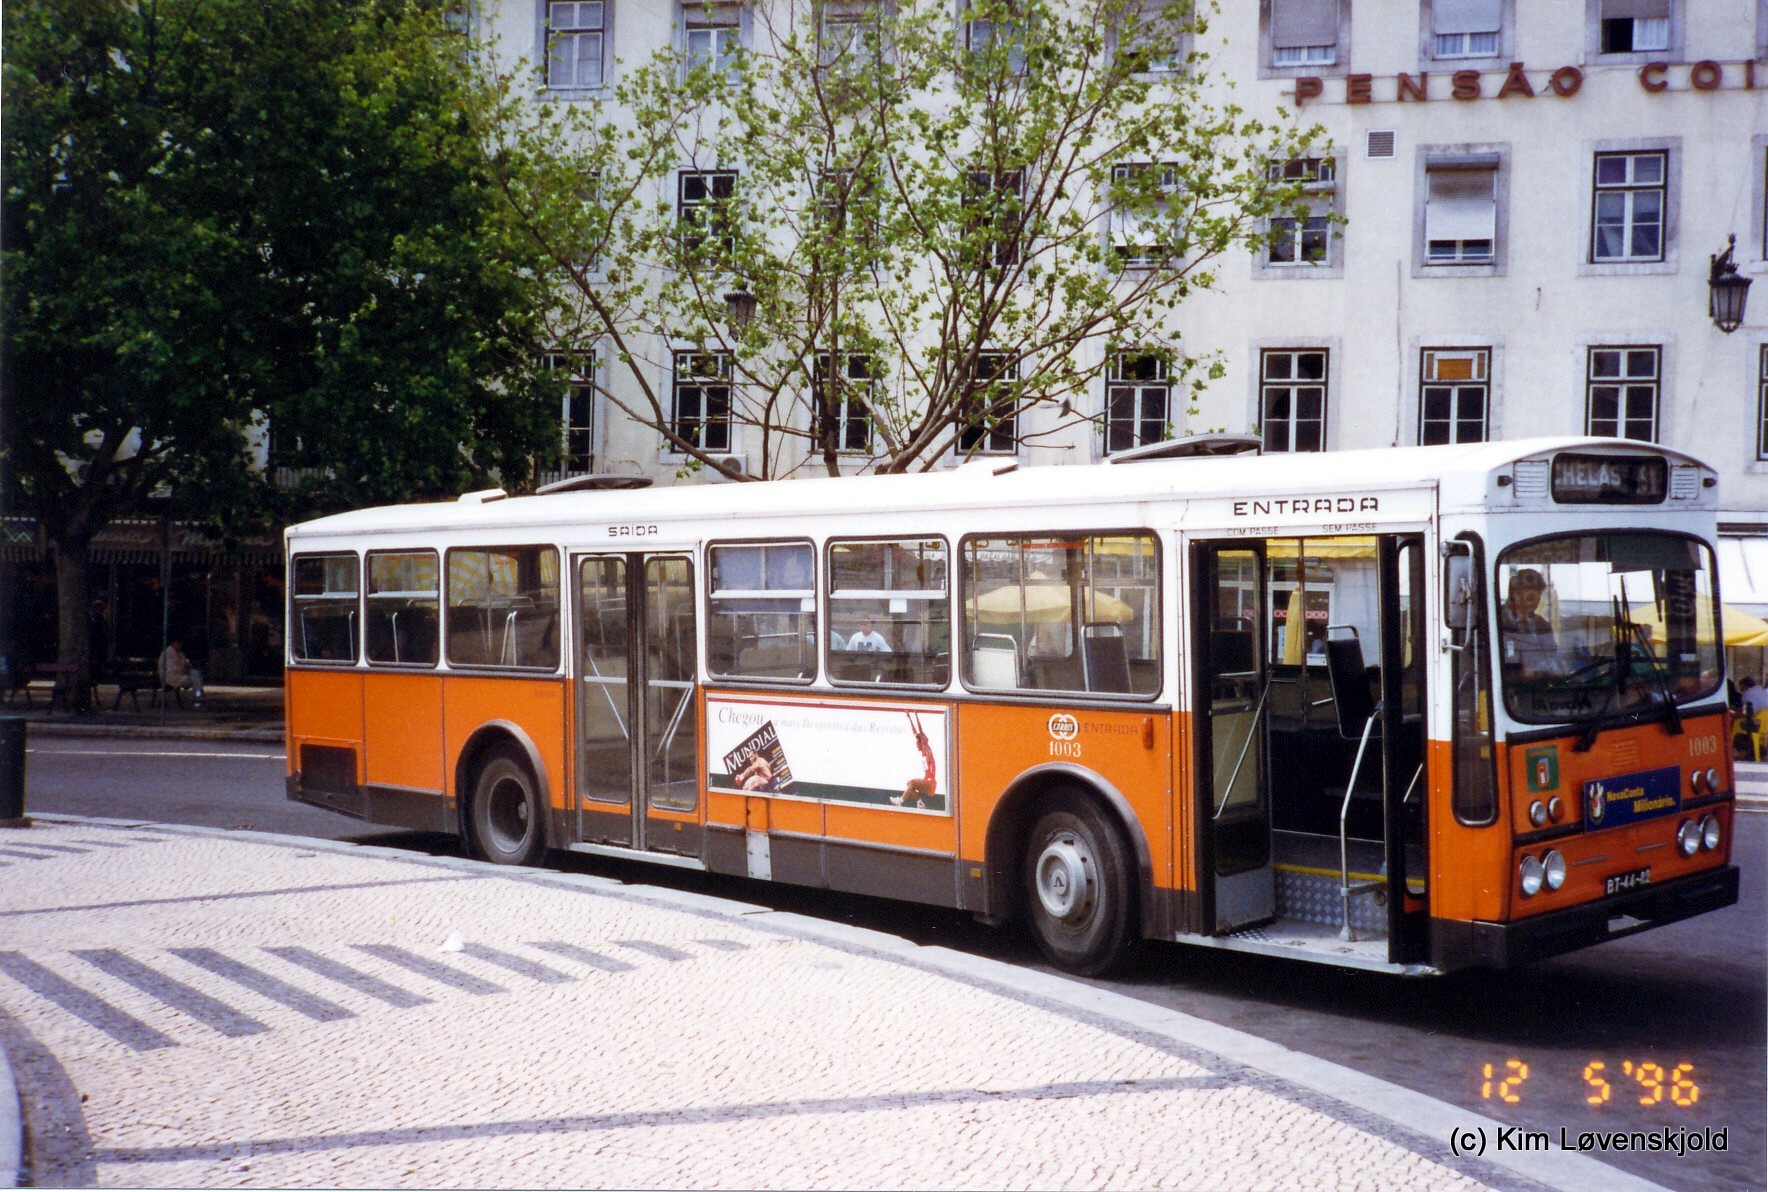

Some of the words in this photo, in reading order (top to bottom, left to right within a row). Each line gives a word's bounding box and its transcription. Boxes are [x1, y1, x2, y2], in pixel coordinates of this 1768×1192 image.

[1296, 62, 1584, 106] PENSÃO
[1233, 497, 1379, 516] ENTRADA
[1249, 526, 1279, 536] PASSE
[1322, 524, 1342, 533] SEM
[1346, 522, 1377, 532] PASSE
[1083, 721, 1139, 736] ENTRADA
[725, 726, 777, 775] MUNDIAL
[1049, 741, 1081, 758] 1003
[1688, 735, 1717, 757] 1003
